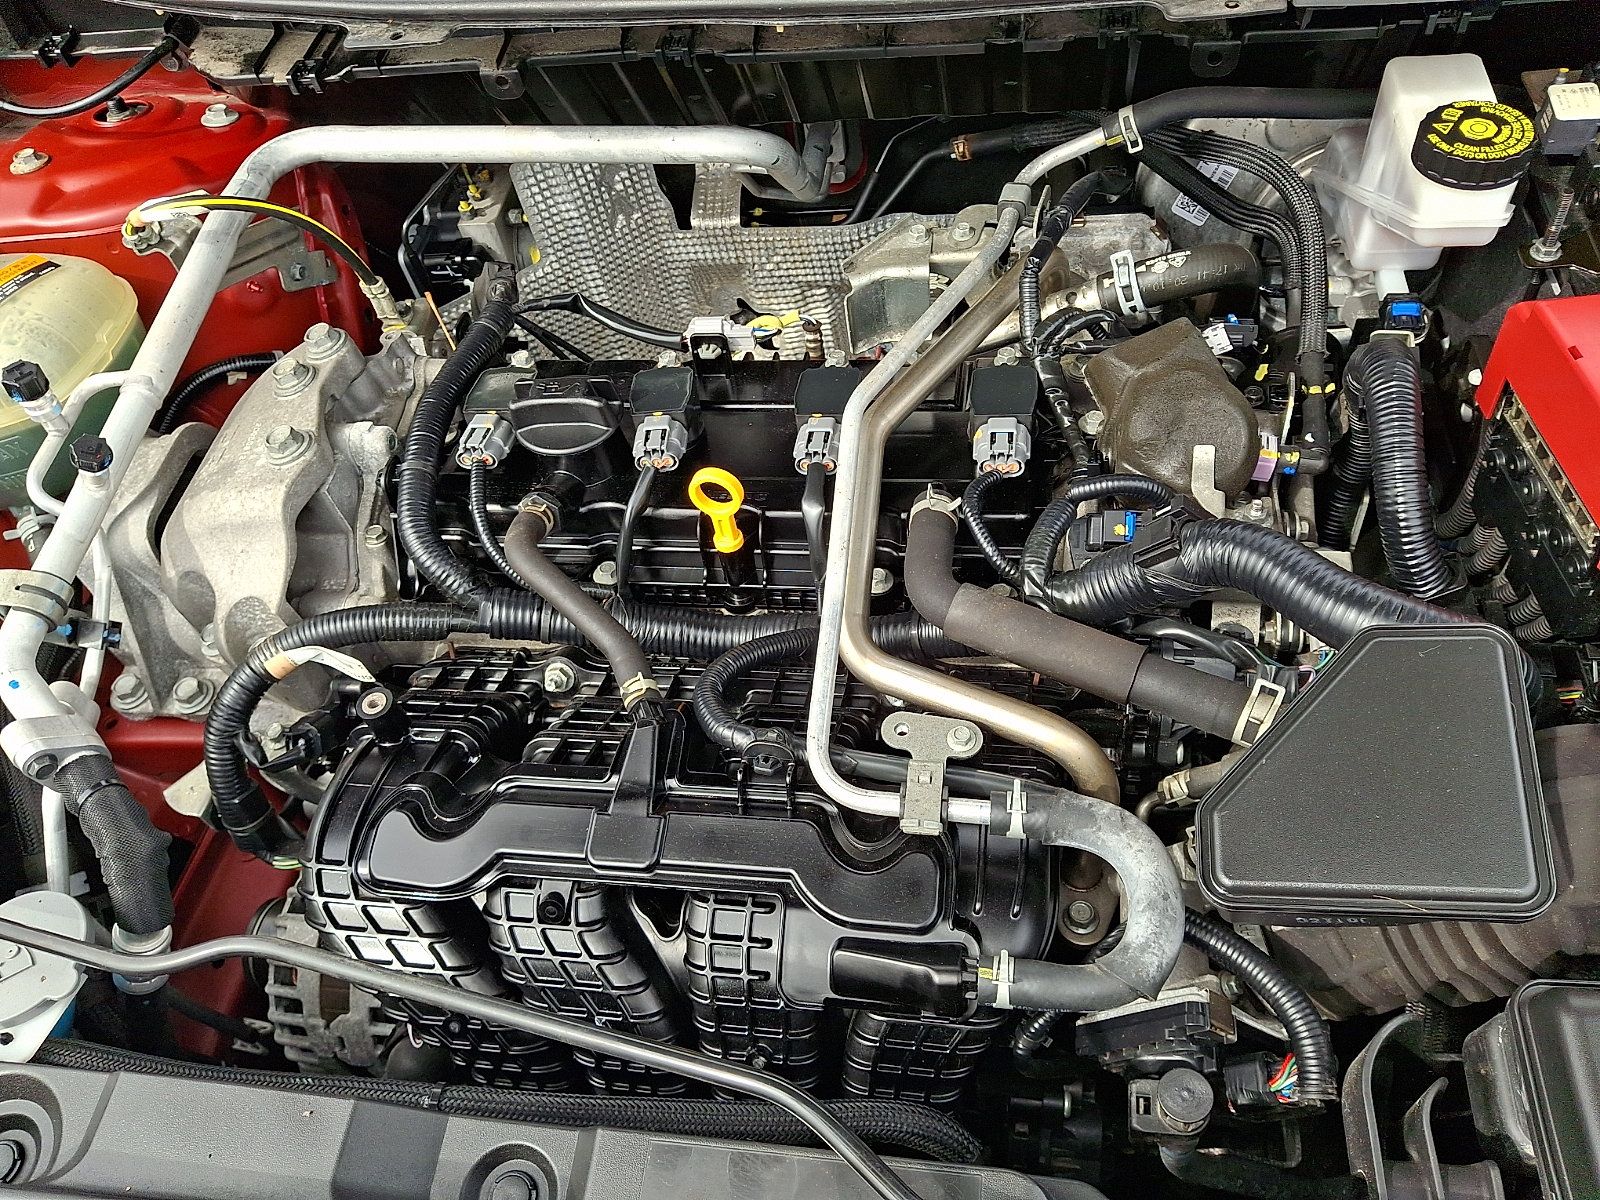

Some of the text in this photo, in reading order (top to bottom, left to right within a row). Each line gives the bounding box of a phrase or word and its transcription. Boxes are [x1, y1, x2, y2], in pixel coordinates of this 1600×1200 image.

[1427, 134, 1439, 143] USE
[1436, 141, 1455, 152] ONLY
[1496, 103, 1522, 117] SEALED
[1454, 107, 1523, 152] CLEAN FILLER CAP BEFORE REMOVING
